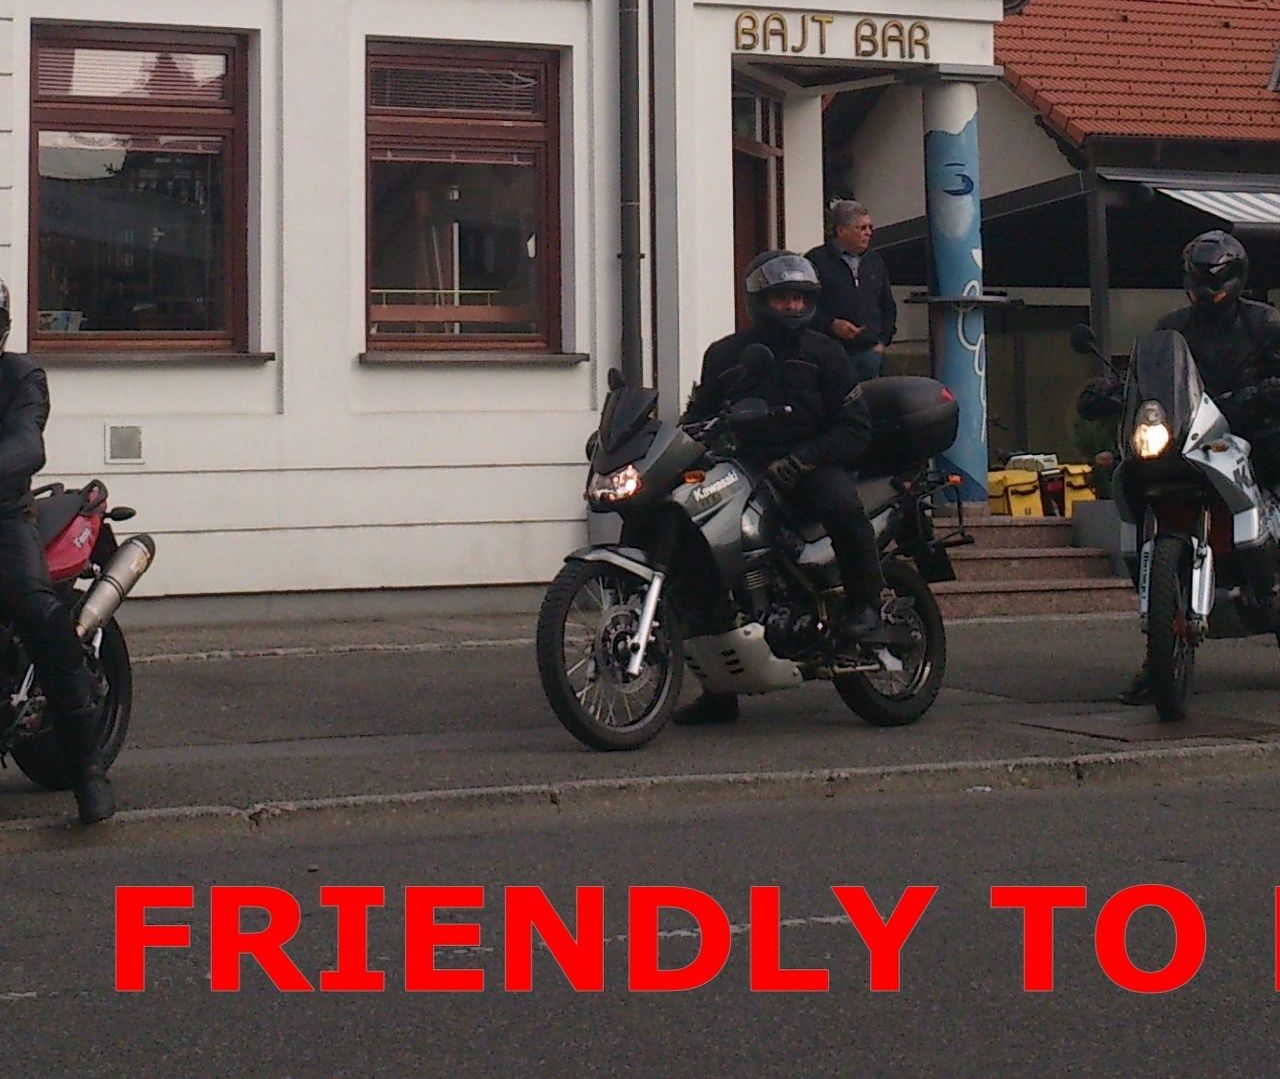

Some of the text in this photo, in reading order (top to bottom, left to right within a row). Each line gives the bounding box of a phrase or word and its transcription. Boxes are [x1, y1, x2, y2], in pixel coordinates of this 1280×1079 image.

[734, 10, 931, 60] BAJT BAR
[693, 469, 739, 502] Kawasaki
